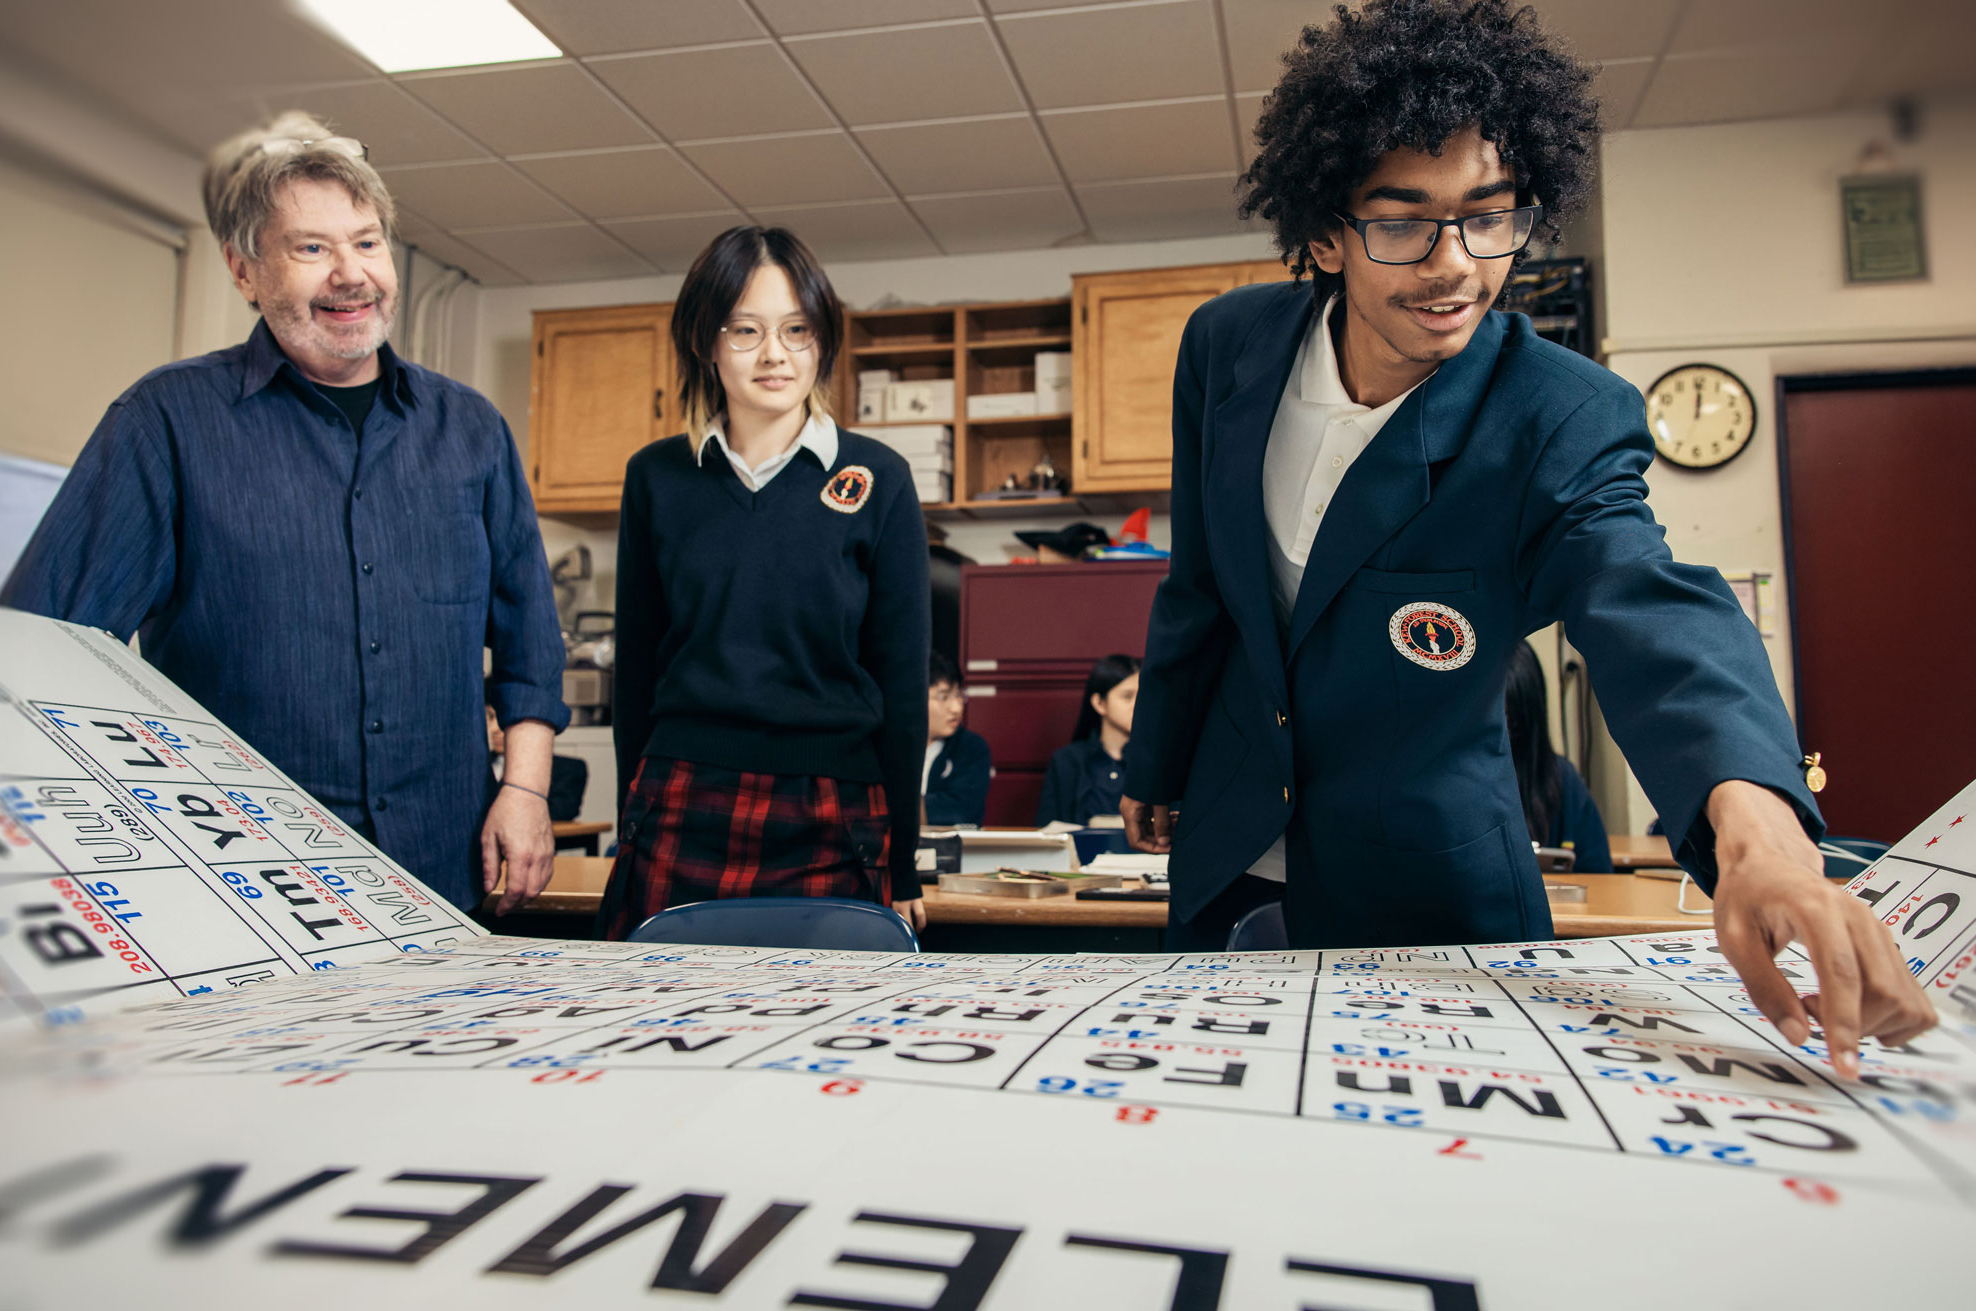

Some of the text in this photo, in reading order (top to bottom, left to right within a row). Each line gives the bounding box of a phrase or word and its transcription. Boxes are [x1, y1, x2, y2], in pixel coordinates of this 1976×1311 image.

[42, 708, 81, 729] 71
[90, 720, 169, 768] Lu
[127, 721, 188, 769] 174.967
[145, 719, 191, 752] 103
[132, 788, 174, 814] 70
[227, 790, 274, 825] 102
[36, 786, 142, 864] Uuh
[103, 804, 156, 842] (289)
[177, 794, 248, 850] Yb
[217, 799, 269, 842] 173.04
[303, 806, 346, 837] (259)
[222, 870, 264, 900] 69
[310, 865, 356, 898] 101
[85, 881, 143, 924] 115
[258, 868, 345, 941] Tm
[289, 865, 370, 933] 168.93421
[335, 864, 433, 927] Md
[16, 902, 106, 969] Bi
[50, 877, 152, 974] 208.98038
[642, 954, 687, 962] 98
[902, 961, 948, 969] 96
[1341, 952, 1450, 963] Np
[1487, 960, 1539, 969] 92
[1519, 948, 1575, 960] U
[1647, 956, 1694, 966] 91
[414, 987, 559, 998] Hg
[585, 986, 719, 994] Au
[1139, 993, 1284, 1006] Os
[1528, 995, 1623, 1007] 106
[278, 1009, 445, 1027] Cd
[469, 1005, 641, 1019] Ag
[670, 1003, 834, 1018] Pd
[890, 1004, 1047, 1022] Rh
[1332, 1011, 1401, 1022] 75
[1344, 1001, 1496, 1018] Re
[630, 1018, 705, 1027] 46
[1088, 1027, 1161, 1040] 44
[1111, 1013, 1271, 1036] Ru
[1588, 1013, 1707, 1036] W
[344, 1038, 520, 1056] Cu
[577, 1035, 735, 1054] Ni
[812, 1035, 997, 1065] Co
[1331, 1044, 1411, 1059] 43
[1360, 1028, 1507, 1057] Tc
[506, 1055, 598, 1068] 28
[757, 1056, 856, 1074] 27
[1085, 1053, 1249, 1088] Fe
[1582, 1047, 1811, 1088] Mo
[531, 1069, 607, 1086] 10
[1594, 1065, 1679, 1085] 42
[819, 1078, 866, 1097] 9
[1036, 1076, 1127, 1099] 26
[1336, 1071, 1571, 1121] Mn
[1633, 1086, 1828, 1116] 51.9961
[1116, 1104, 1160, 1127] 8
[1332, 1102, 1425, 1129] 25
[1661, 1105, 1860, 1155] Cr
[1437, 1139, 1484, 1162] 7
[1649, 1137, 1758, 1168] 24
